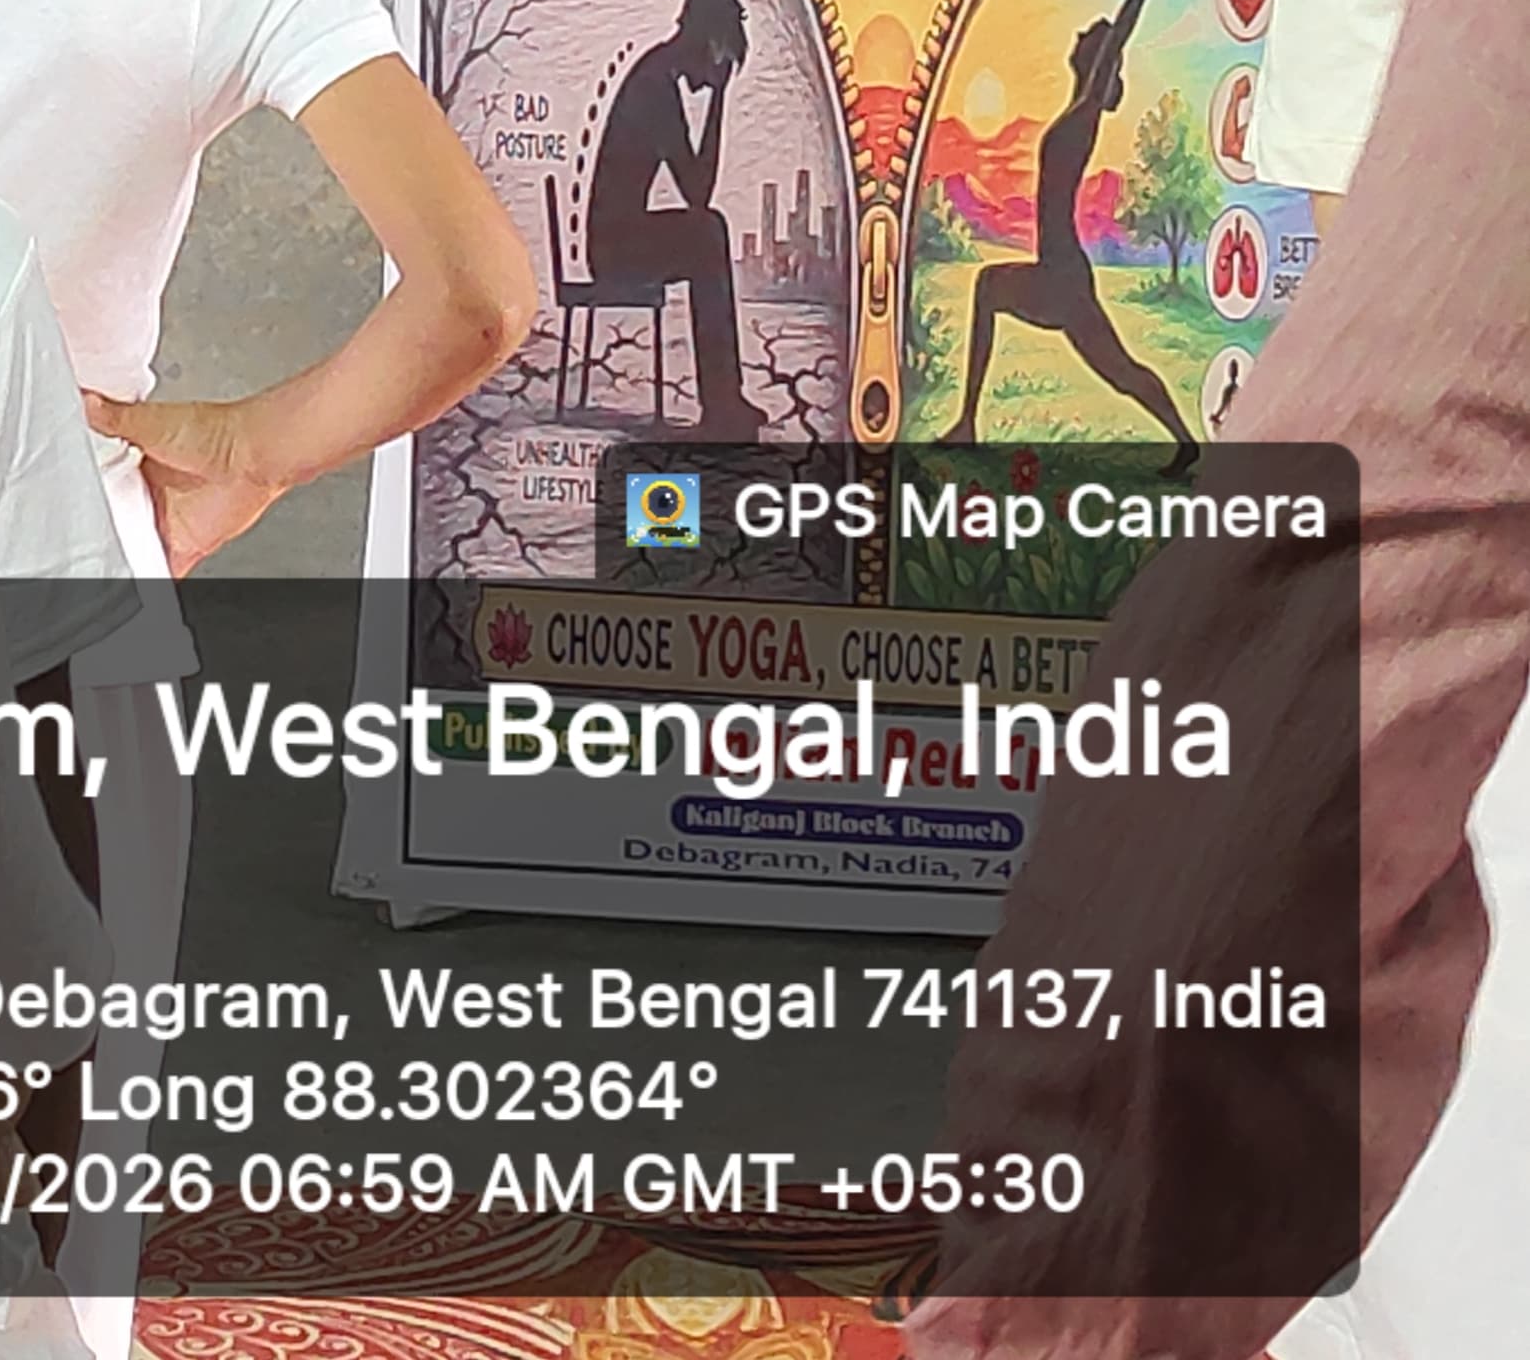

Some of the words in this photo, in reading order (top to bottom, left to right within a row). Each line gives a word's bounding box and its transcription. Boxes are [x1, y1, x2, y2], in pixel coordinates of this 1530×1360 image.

[513, 94, 549, 122] BAD
[495, 131, 568, 162] POSTURE
[516, 439, 611, 468] UNHEALTHY
[523, 475, 605, 504] LIFESTYLE
[546, 619, 673, 670] CHOOSE
[689, 614, 826, 690] YOGA,
[842, 629, 963, 685] CHOOSE
[976, 637, 997, 689] A
[685, 803, 808, 838] Kaliganj
[811, 810, 895, 838] Block
[901, 816, 1011, 844] Branch
[623, 838, 831, 876] Debagram,
[841, 851, 961, 881] Nadia,
